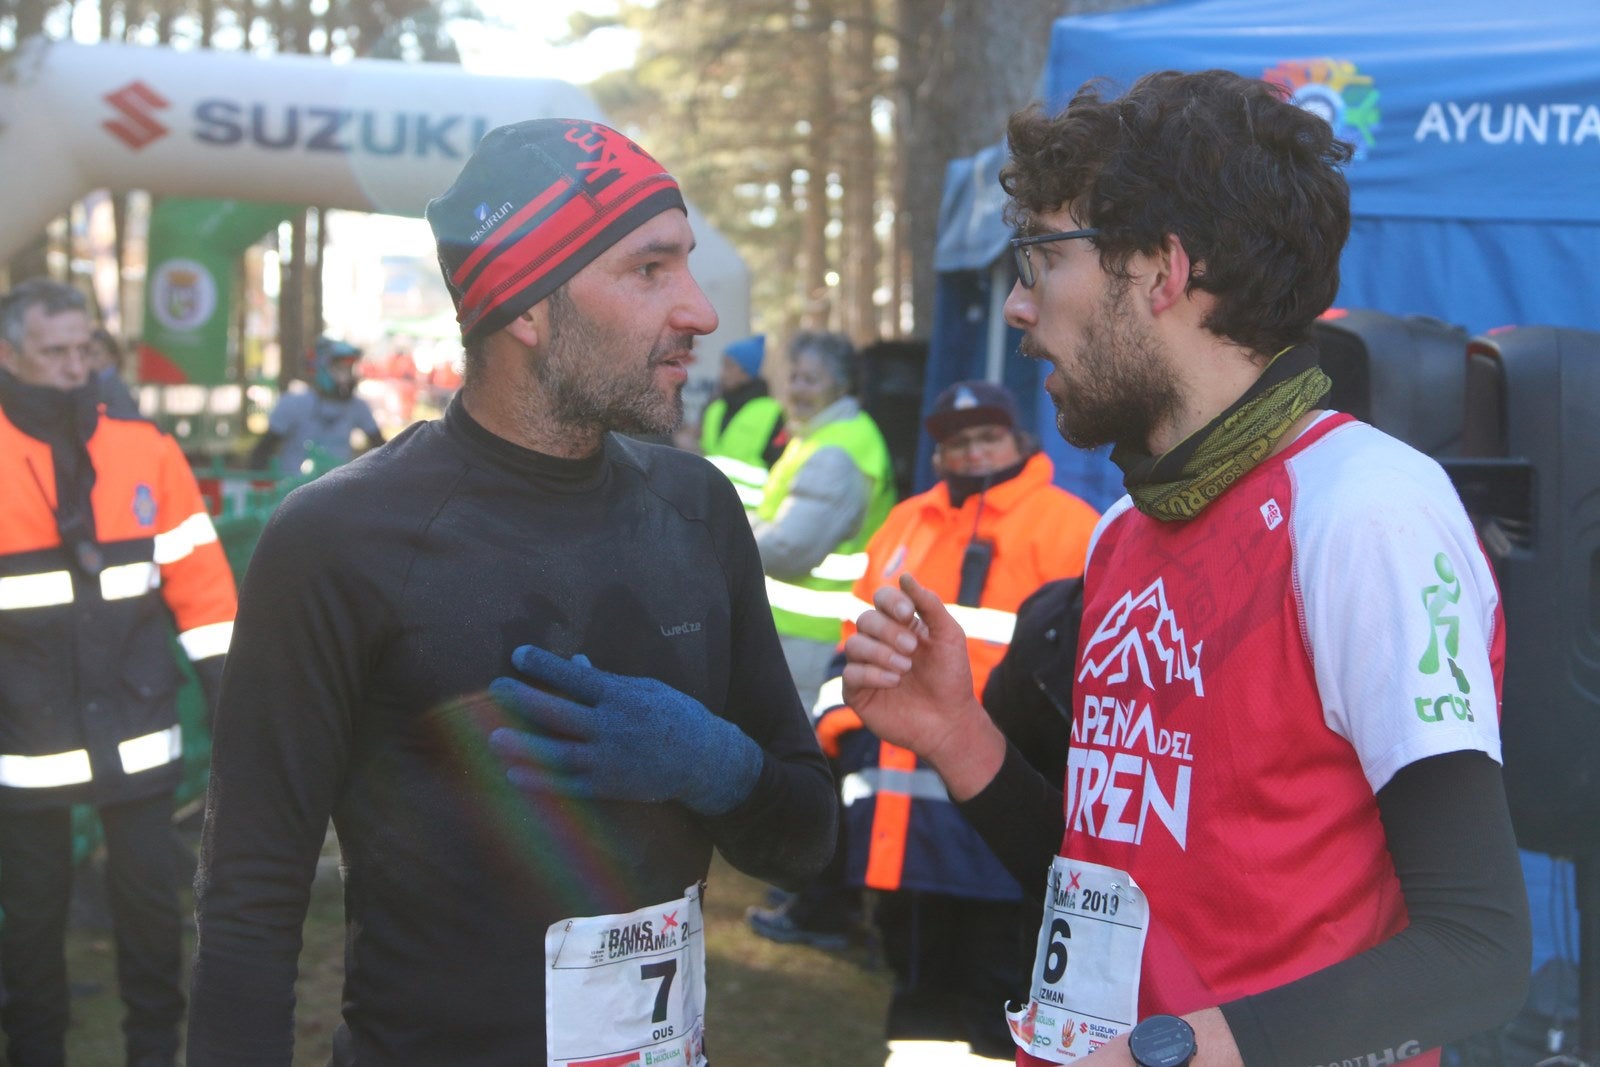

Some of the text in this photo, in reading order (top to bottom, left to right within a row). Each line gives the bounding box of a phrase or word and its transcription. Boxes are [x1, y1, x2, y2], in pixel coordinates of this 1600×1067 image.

[194, 97, 489, 157] SUZUKI
[1414, 102, 1600, 145] AYUNTA
[1156, 728, 1194, 761] DEL
[1066, 746, 1193, 852] TREN
[1081, 888, 1119, 916] 2019
[1043, 917, 1071, 985] 6
[640, 957, 677, 1024] 7
[652, 1025, 674, 1041] OUS
[1089, 1023, 1118, 1036] SUZUKI
